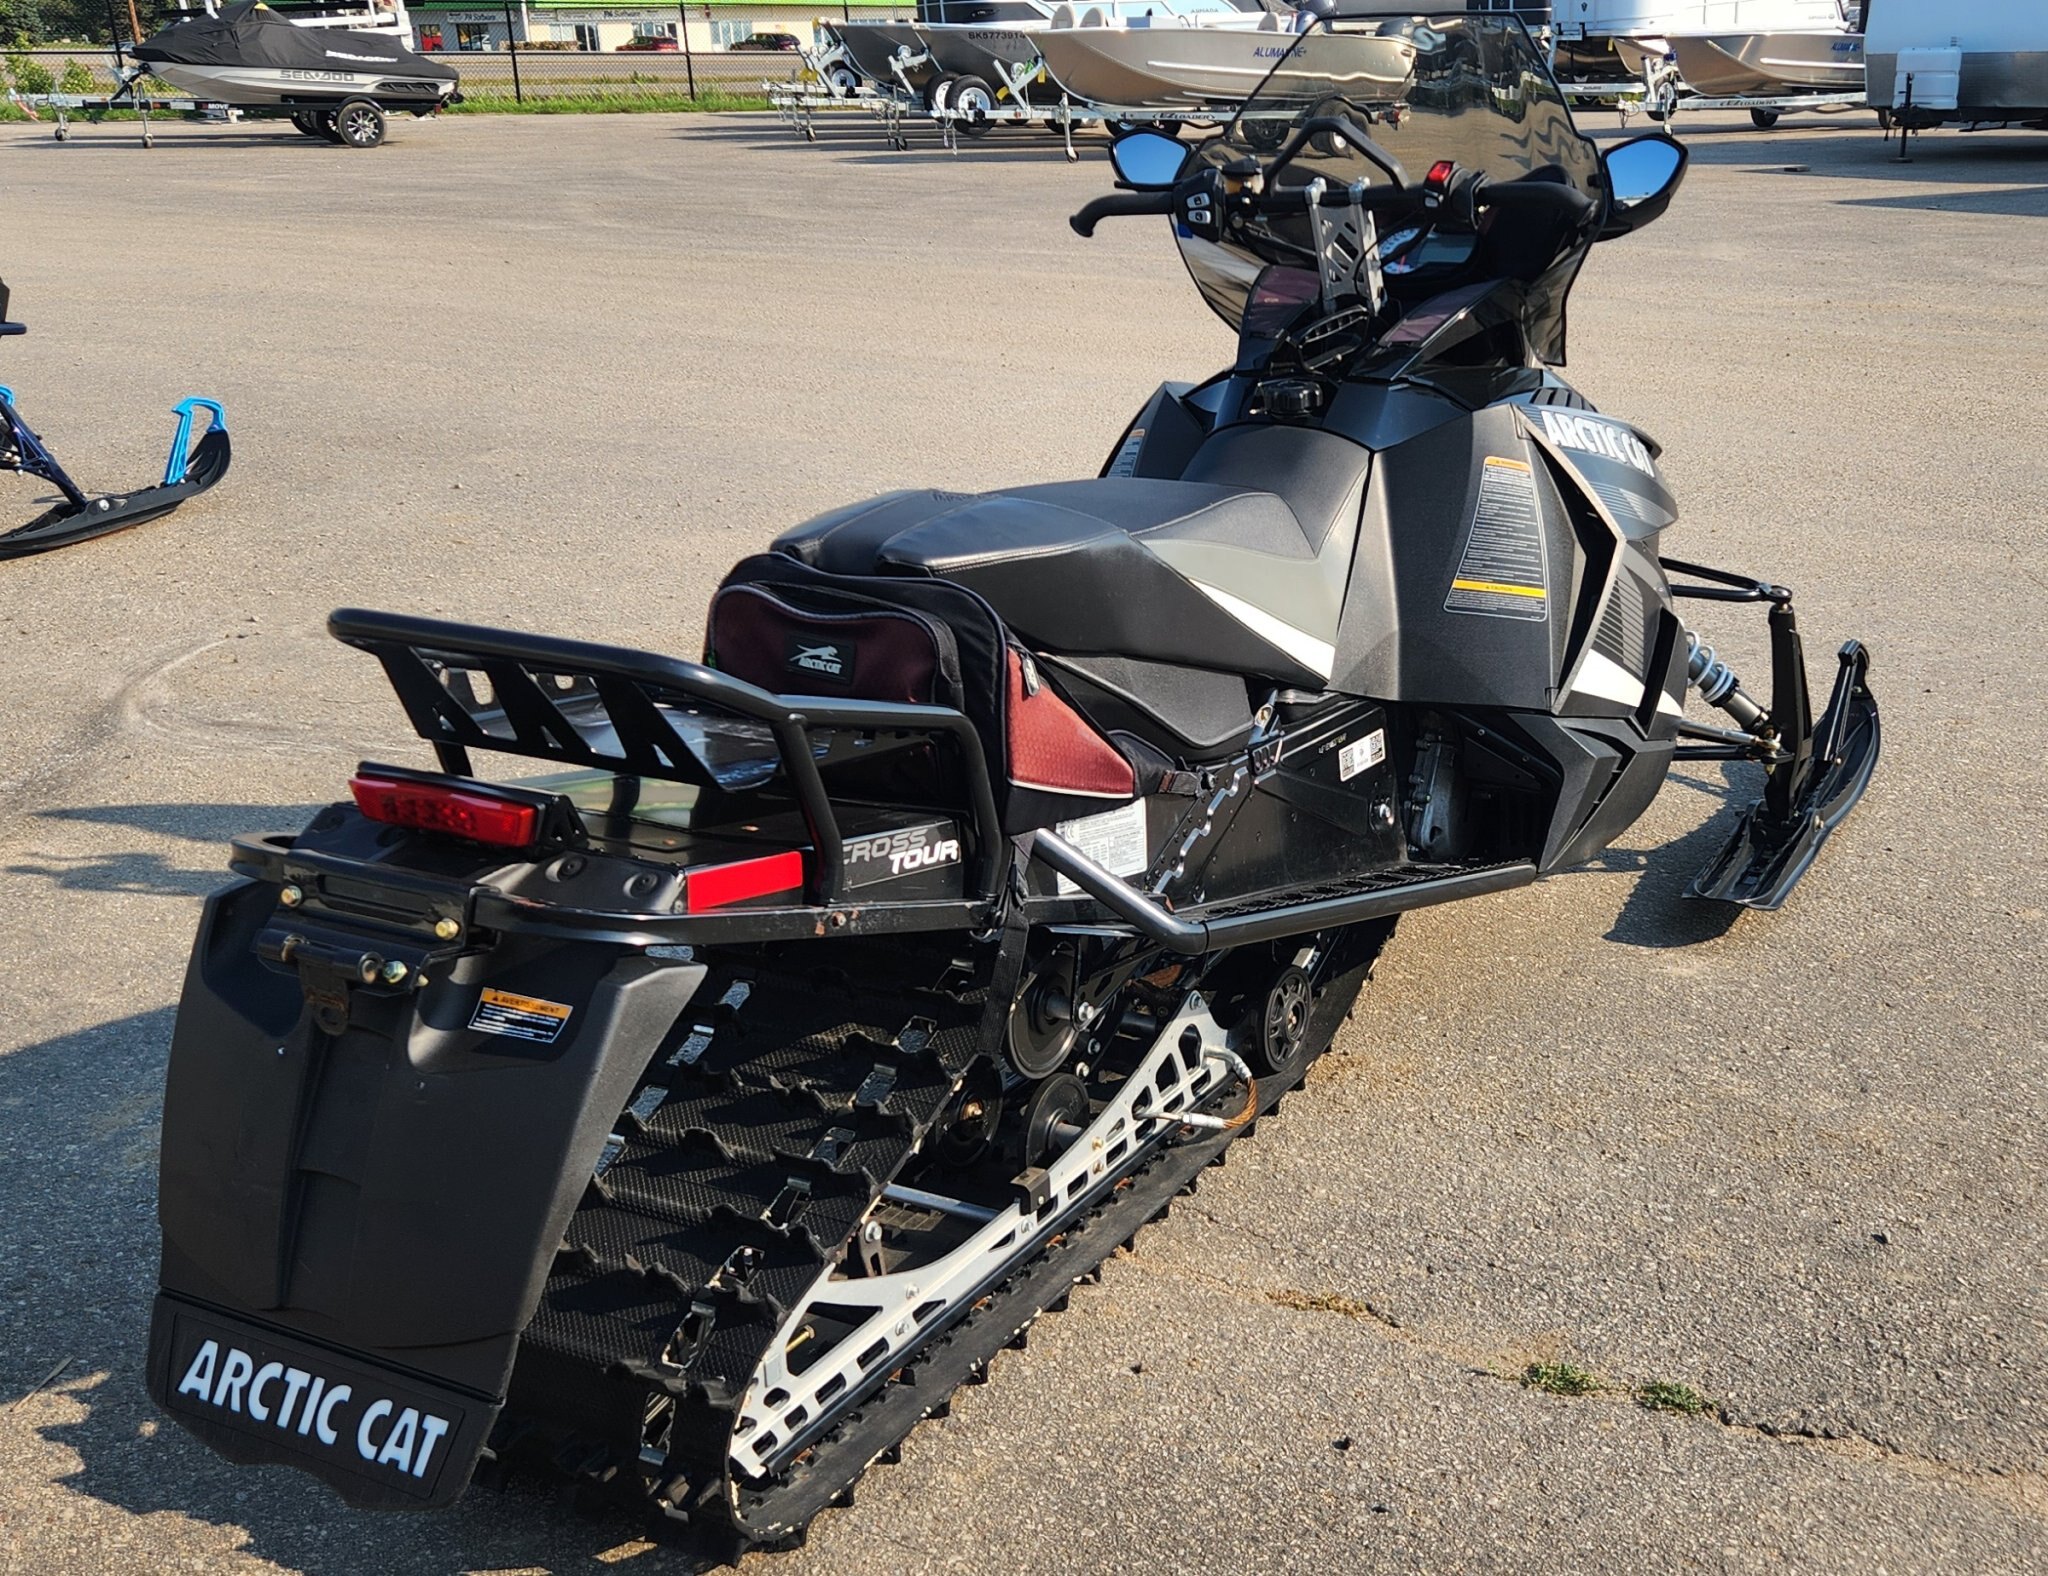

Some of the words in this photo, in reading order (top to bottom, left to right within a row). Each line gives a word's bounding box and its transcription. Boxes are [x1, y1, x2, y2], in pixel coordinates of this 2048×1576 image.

[1541, 410, 1628, 464] ARCTIC
[1622, 432, 1655, 478] CAT
[888, 839, 959, 875] TOUR
[178, 1339, 353, 1446] ARCTIC
[357, 1399, 449, 1479] CAT
